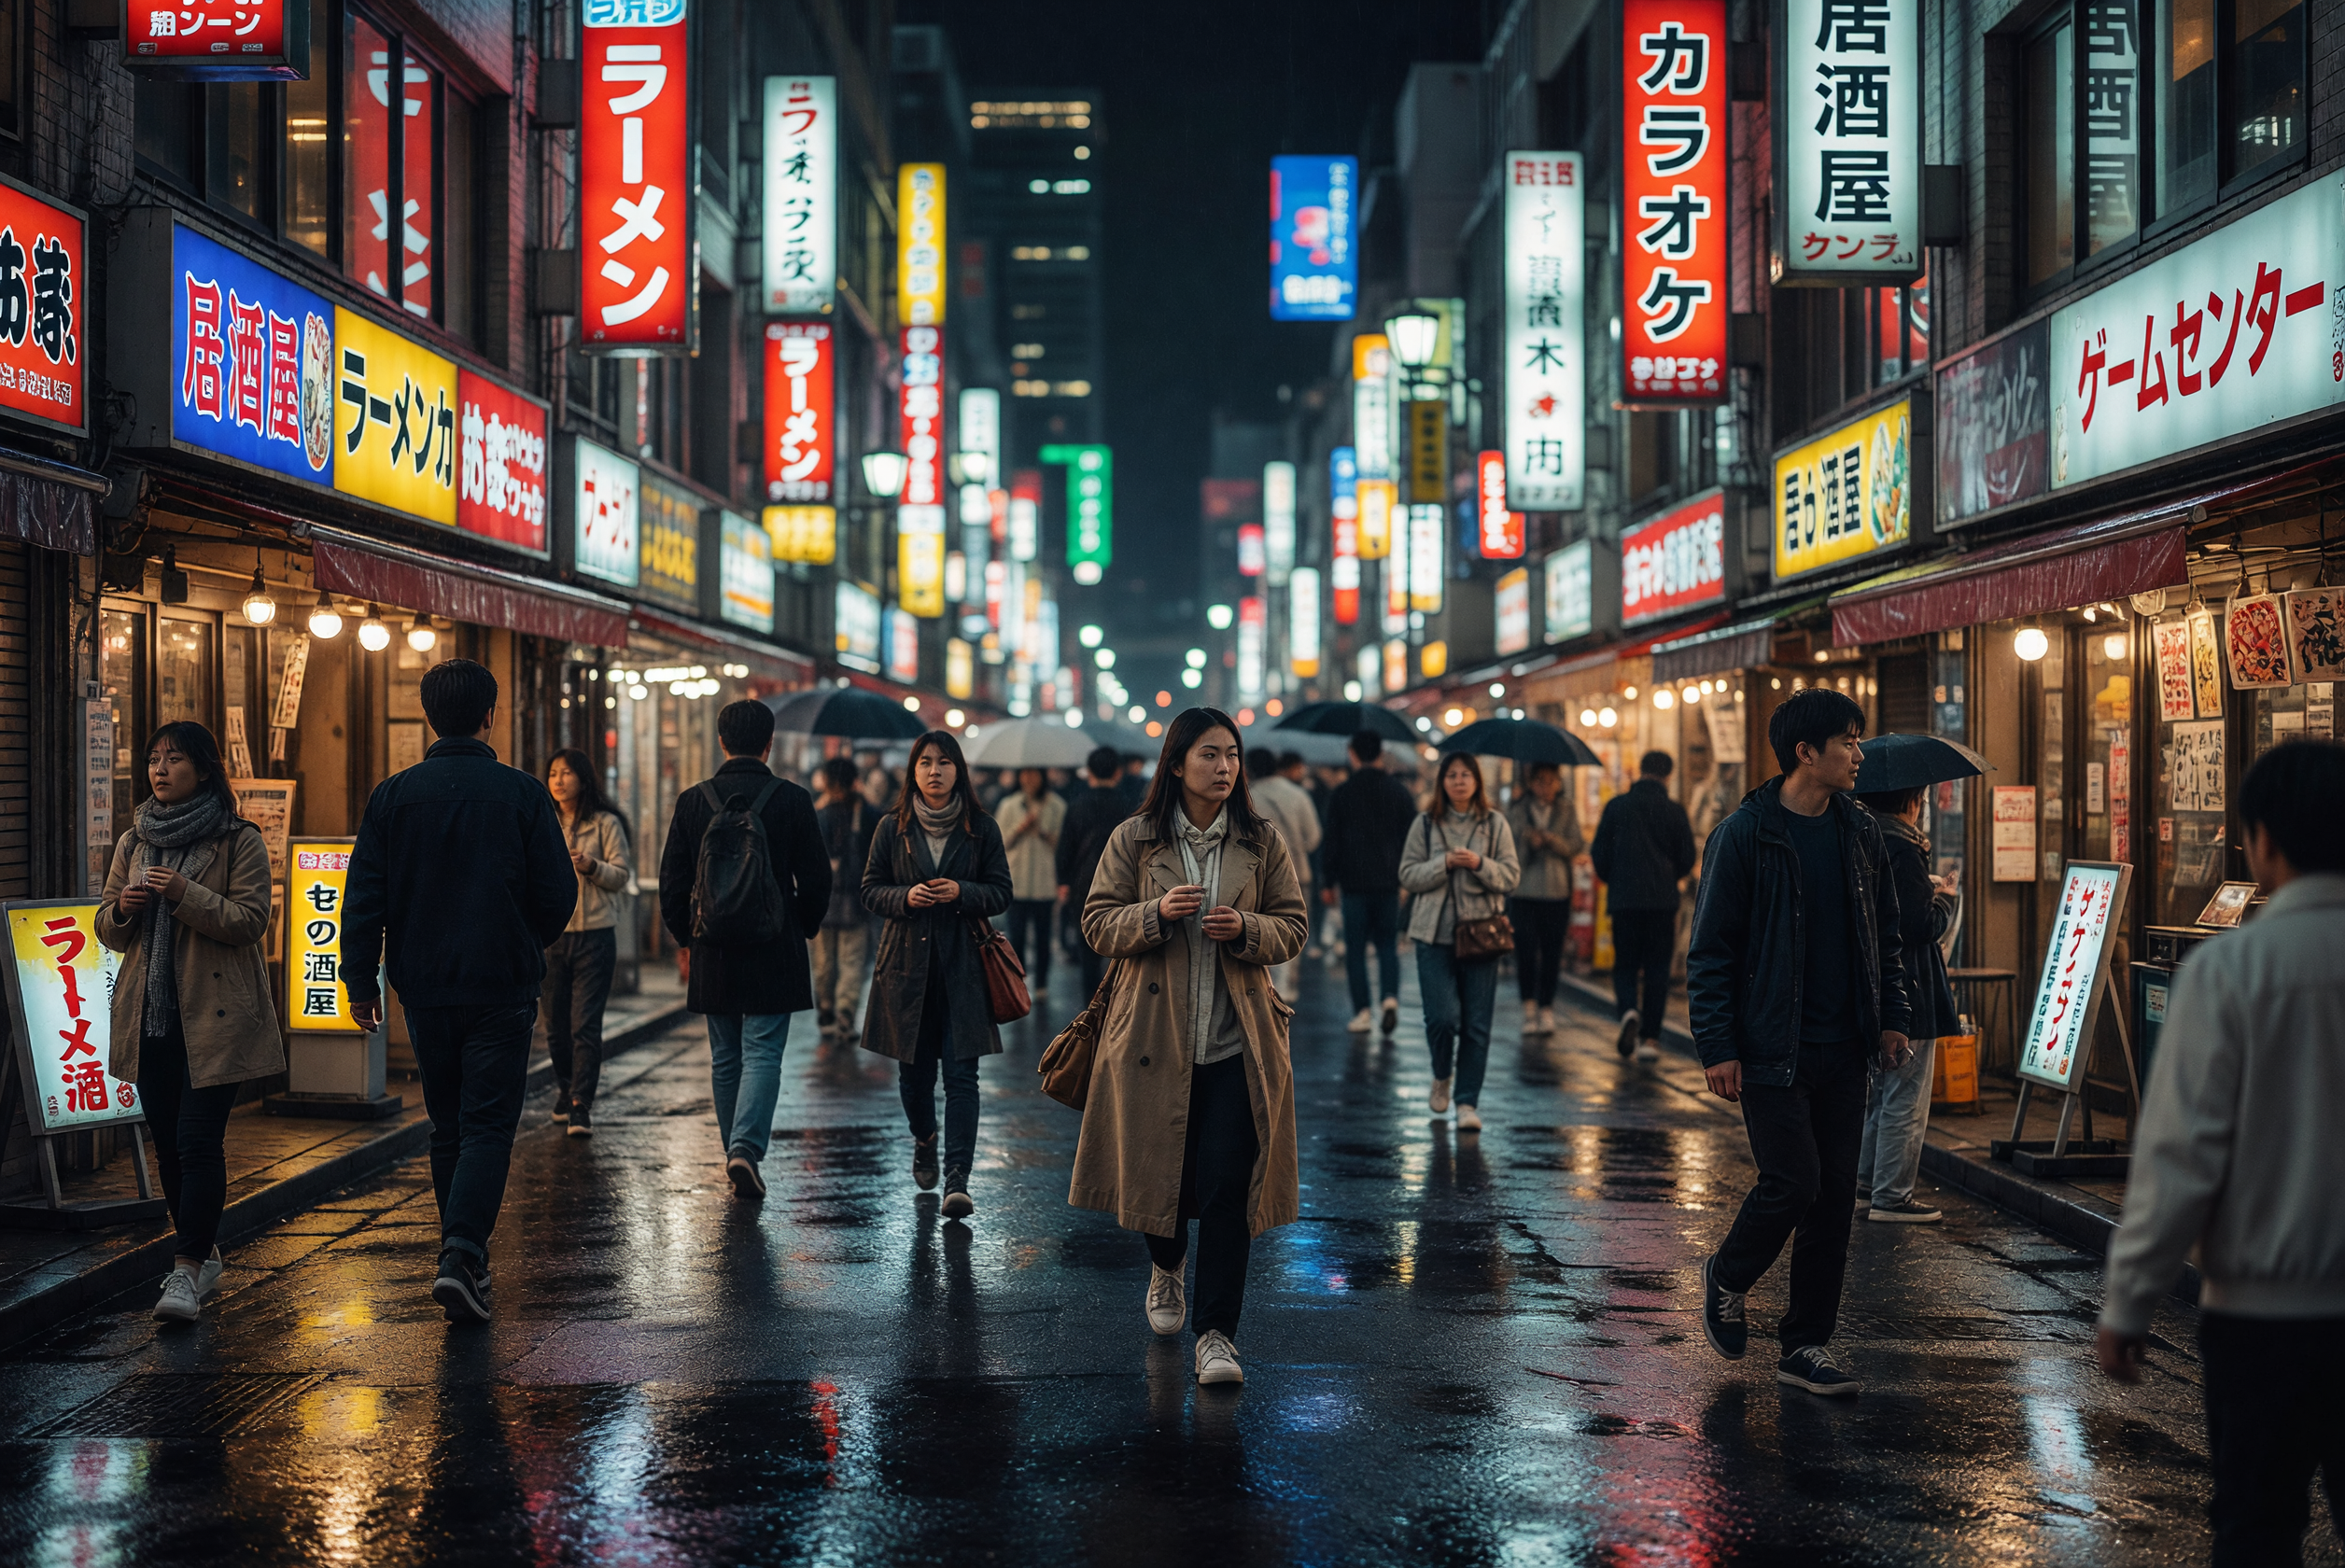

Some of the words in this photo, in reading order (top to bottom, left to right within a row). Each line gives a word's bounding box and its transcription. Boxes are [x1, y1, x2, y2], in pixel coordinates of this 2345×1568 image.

[600, 44, 670, 327] ラーメン
[1636, 21, 1712, 344] カラオケ
[1814, 0, 1892, 223] 居酒屋
[779, 336, 821, 483] ラーメン
[2078, 261, 2325, 435] ゲームセンター
